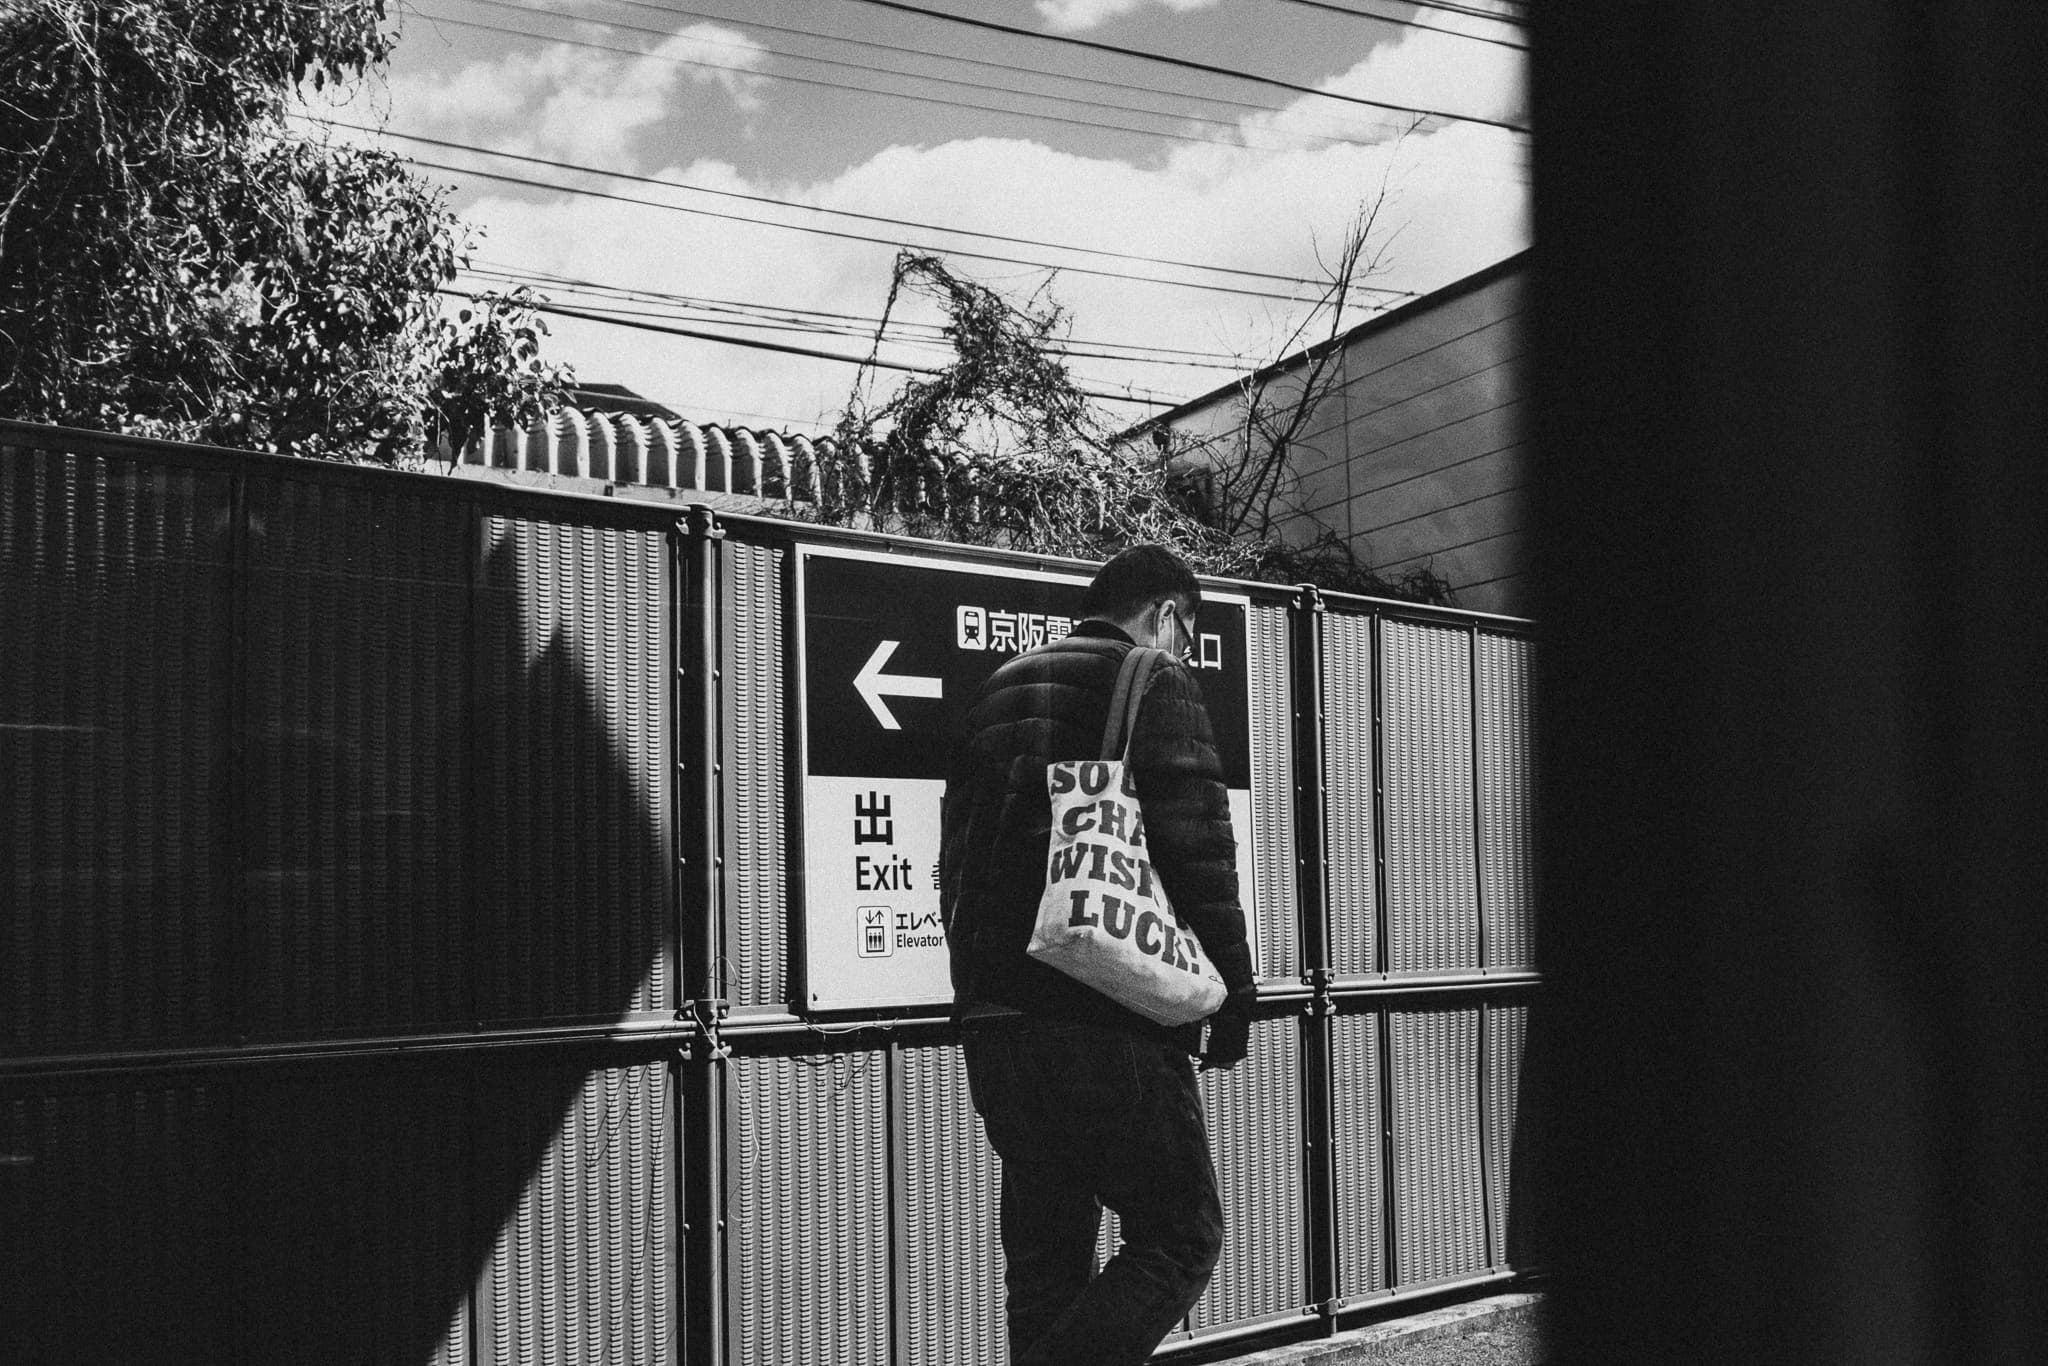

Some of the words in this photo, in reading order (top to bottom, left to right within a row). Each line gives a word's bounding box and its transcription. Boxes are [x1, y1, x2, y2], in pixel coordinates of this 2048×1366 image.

[988, 609, 1082, 653] 京阪電
[1051, 762, 1110, 796] SO
[855, 791, 893, 845] 出
[856, 854, 913, 890] Exit
[896, 933, 944, 949] Elevator
[1068, 890, 1200, 975] LUCK!
